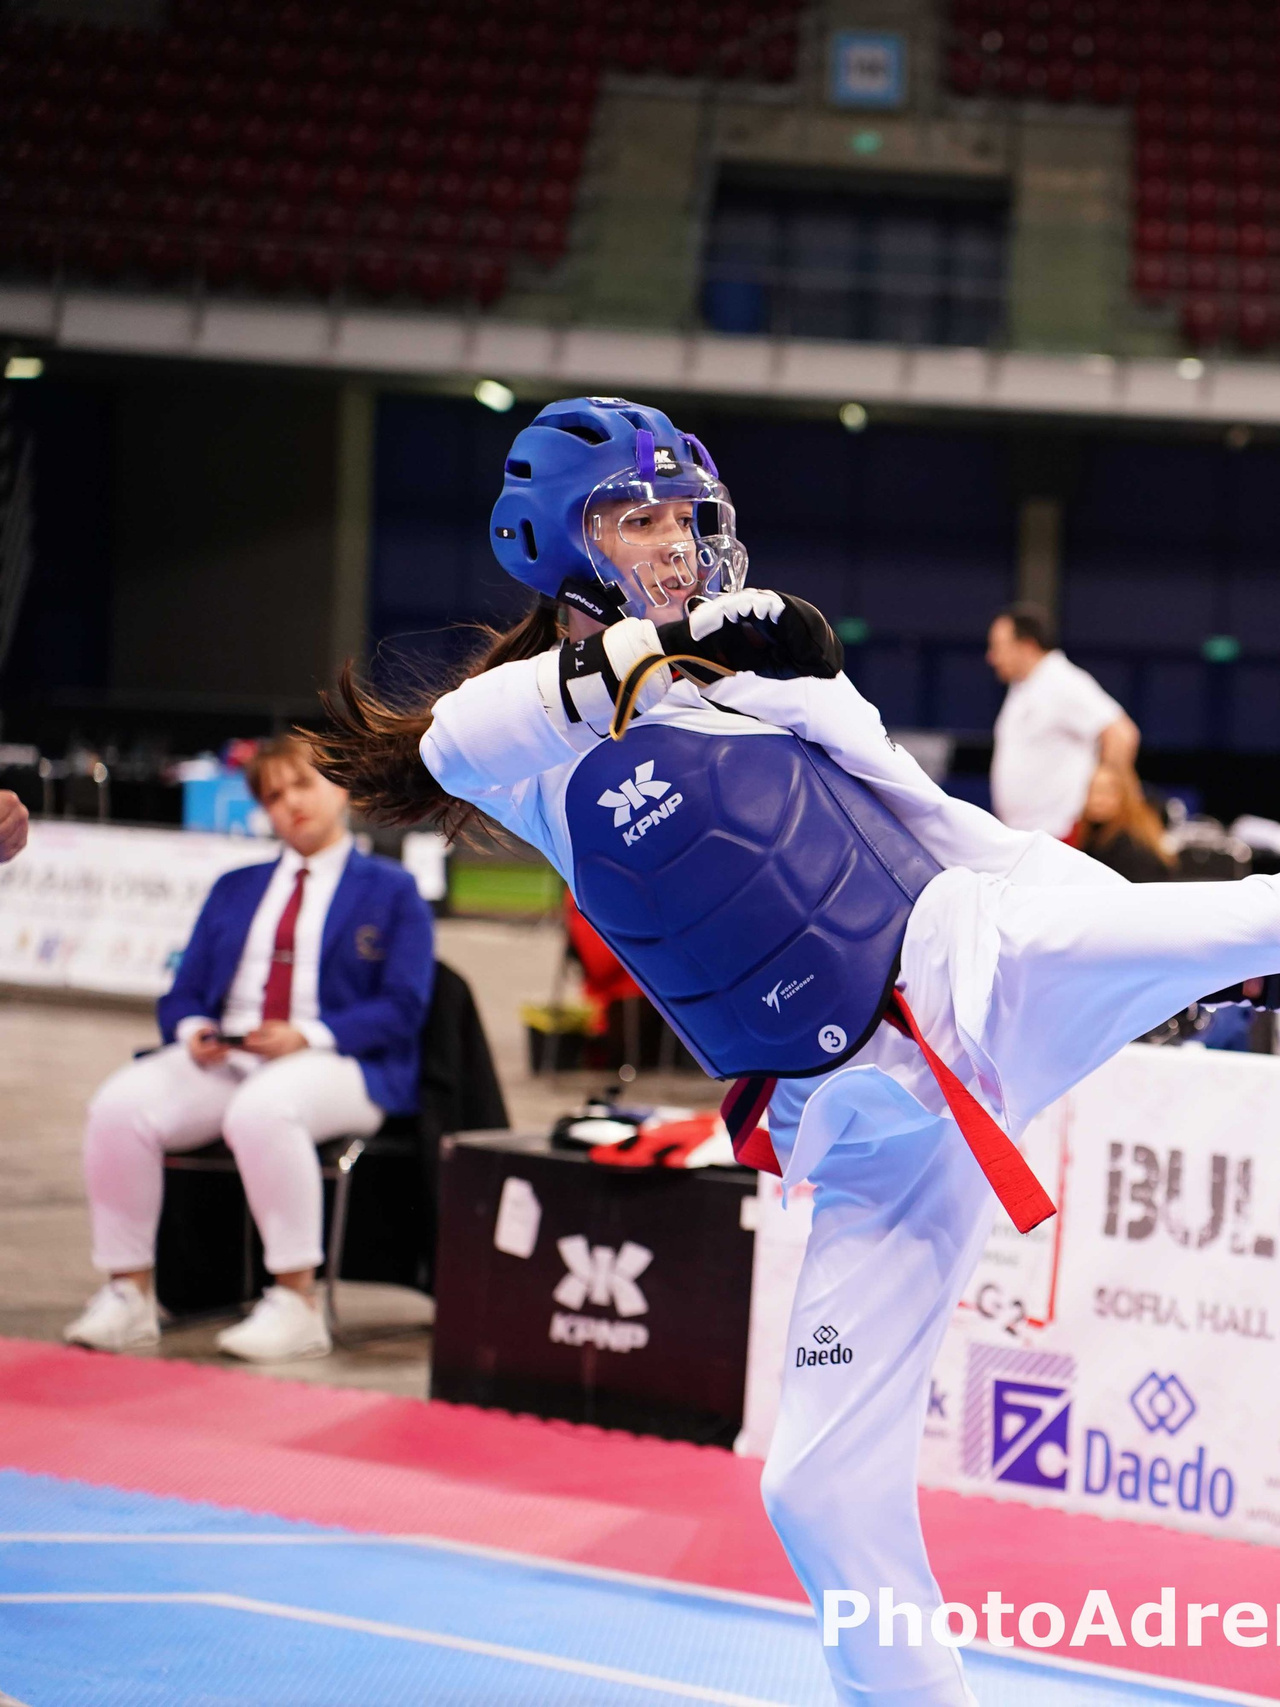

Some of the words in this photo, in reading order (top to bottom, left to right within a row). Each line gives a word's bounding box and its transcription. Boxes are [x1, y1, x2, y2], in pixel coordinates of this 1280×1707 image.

[565, 591, 604, 616] KPNP
[622, 792, 684, 847] KPNP
[780, 980, 798, 996] WORLD
[783, 974, 815, 1000] TAEKWONDO
[824, 1030, 841, 1047] 3
[795, 1343, 854, 1368] Daedo
[1084, 1428, 1235, 1518] Daedo
